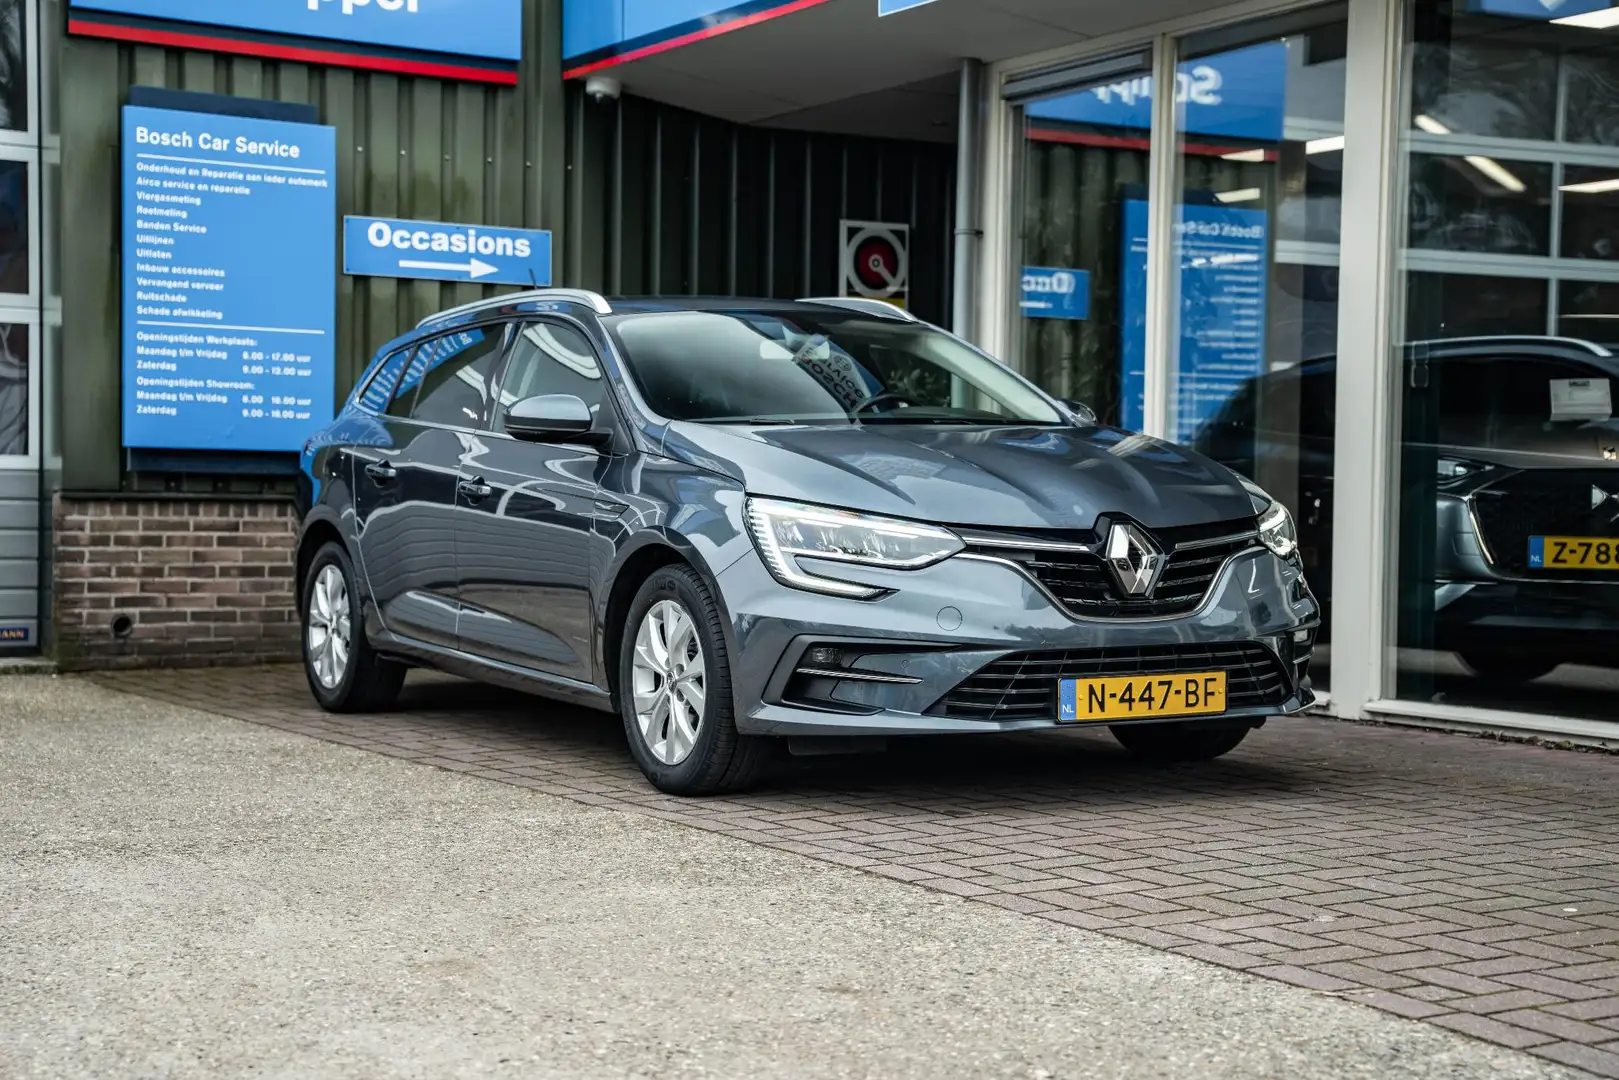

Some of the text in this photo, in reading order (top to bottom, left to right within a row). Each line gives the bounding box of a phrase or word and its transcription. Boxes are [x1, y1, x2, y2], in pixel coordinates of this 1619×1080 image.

[135, 126, 300, 158] Bosch Car Service
[136, 162, 187, 176] Onderhoud
[188, 168, 200, 176] en
[201, 167, 244, 180] Reparatie
[245, 173, 262, 182] aan
[287, 177, 328, 188] automerk
[136, 176, 251, 196] Airco service en reparatie
[136, 190, 202, 207] Viergasmeting
[136, 204, 188, 219] Roetmeting
[136, 219, 208, 234] Banden Service
[367, 221, 532, 258] Occasions
[136, 247, 173, 260] Uitlaten
[136, 261, 226, 278] Inbouw accessoires
[136, 276, 225, 291] Vervangend vervoer
[136, 290, 188, 303] Ruitschade
[136, 304, 223, 320] Schade afwikkeling
[136, 331, 258, 347] Openingstijden Werkplaats:
[136, 346, 178, 358] Maandag
[179, 348, 194, 358] t/m
[195, 348, 228, 360] Vrijdag
[296, 355, 312, 363] uur
[136, 360, 178, 372] Zaterdag
[297, 369, 312, 377] uur
[136, 376, 257, 391] Openingstijden Showroom:
[136, 390, 178, 402] Maandag
[179, 393, 194, 402] t/m
[195, 393, 228, 404] Vrijdag
[136, 404, 178, 417] Zaterdag
[295, 411, 311, 420] uur
[1087, 677, 1218, 714] N-447-BF
[1062, 702, 1075, 713] NL
